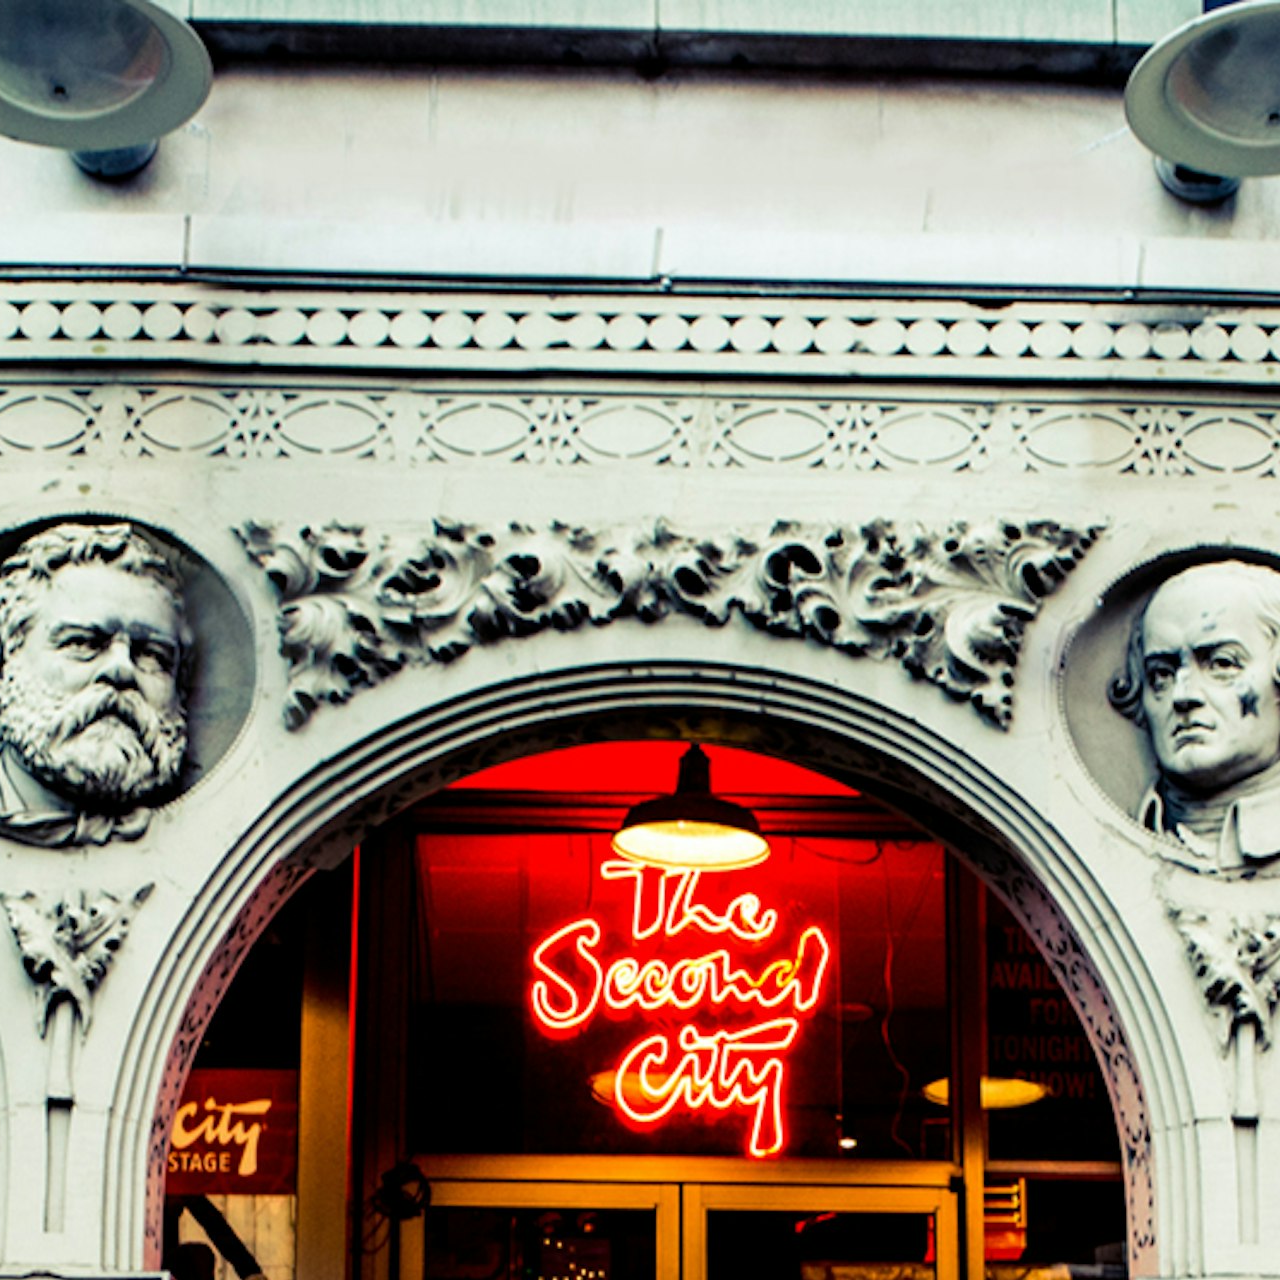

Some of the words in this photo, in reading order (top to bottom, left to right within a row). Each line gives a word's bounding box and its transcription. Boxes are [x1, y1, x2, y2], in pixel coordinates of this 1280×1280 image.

[600, 860, 777, 940] The
[532, 919, 829, 1028] Second
[615, 1018, 799, 1157] City
[170, 1096, 272, 1177] City
